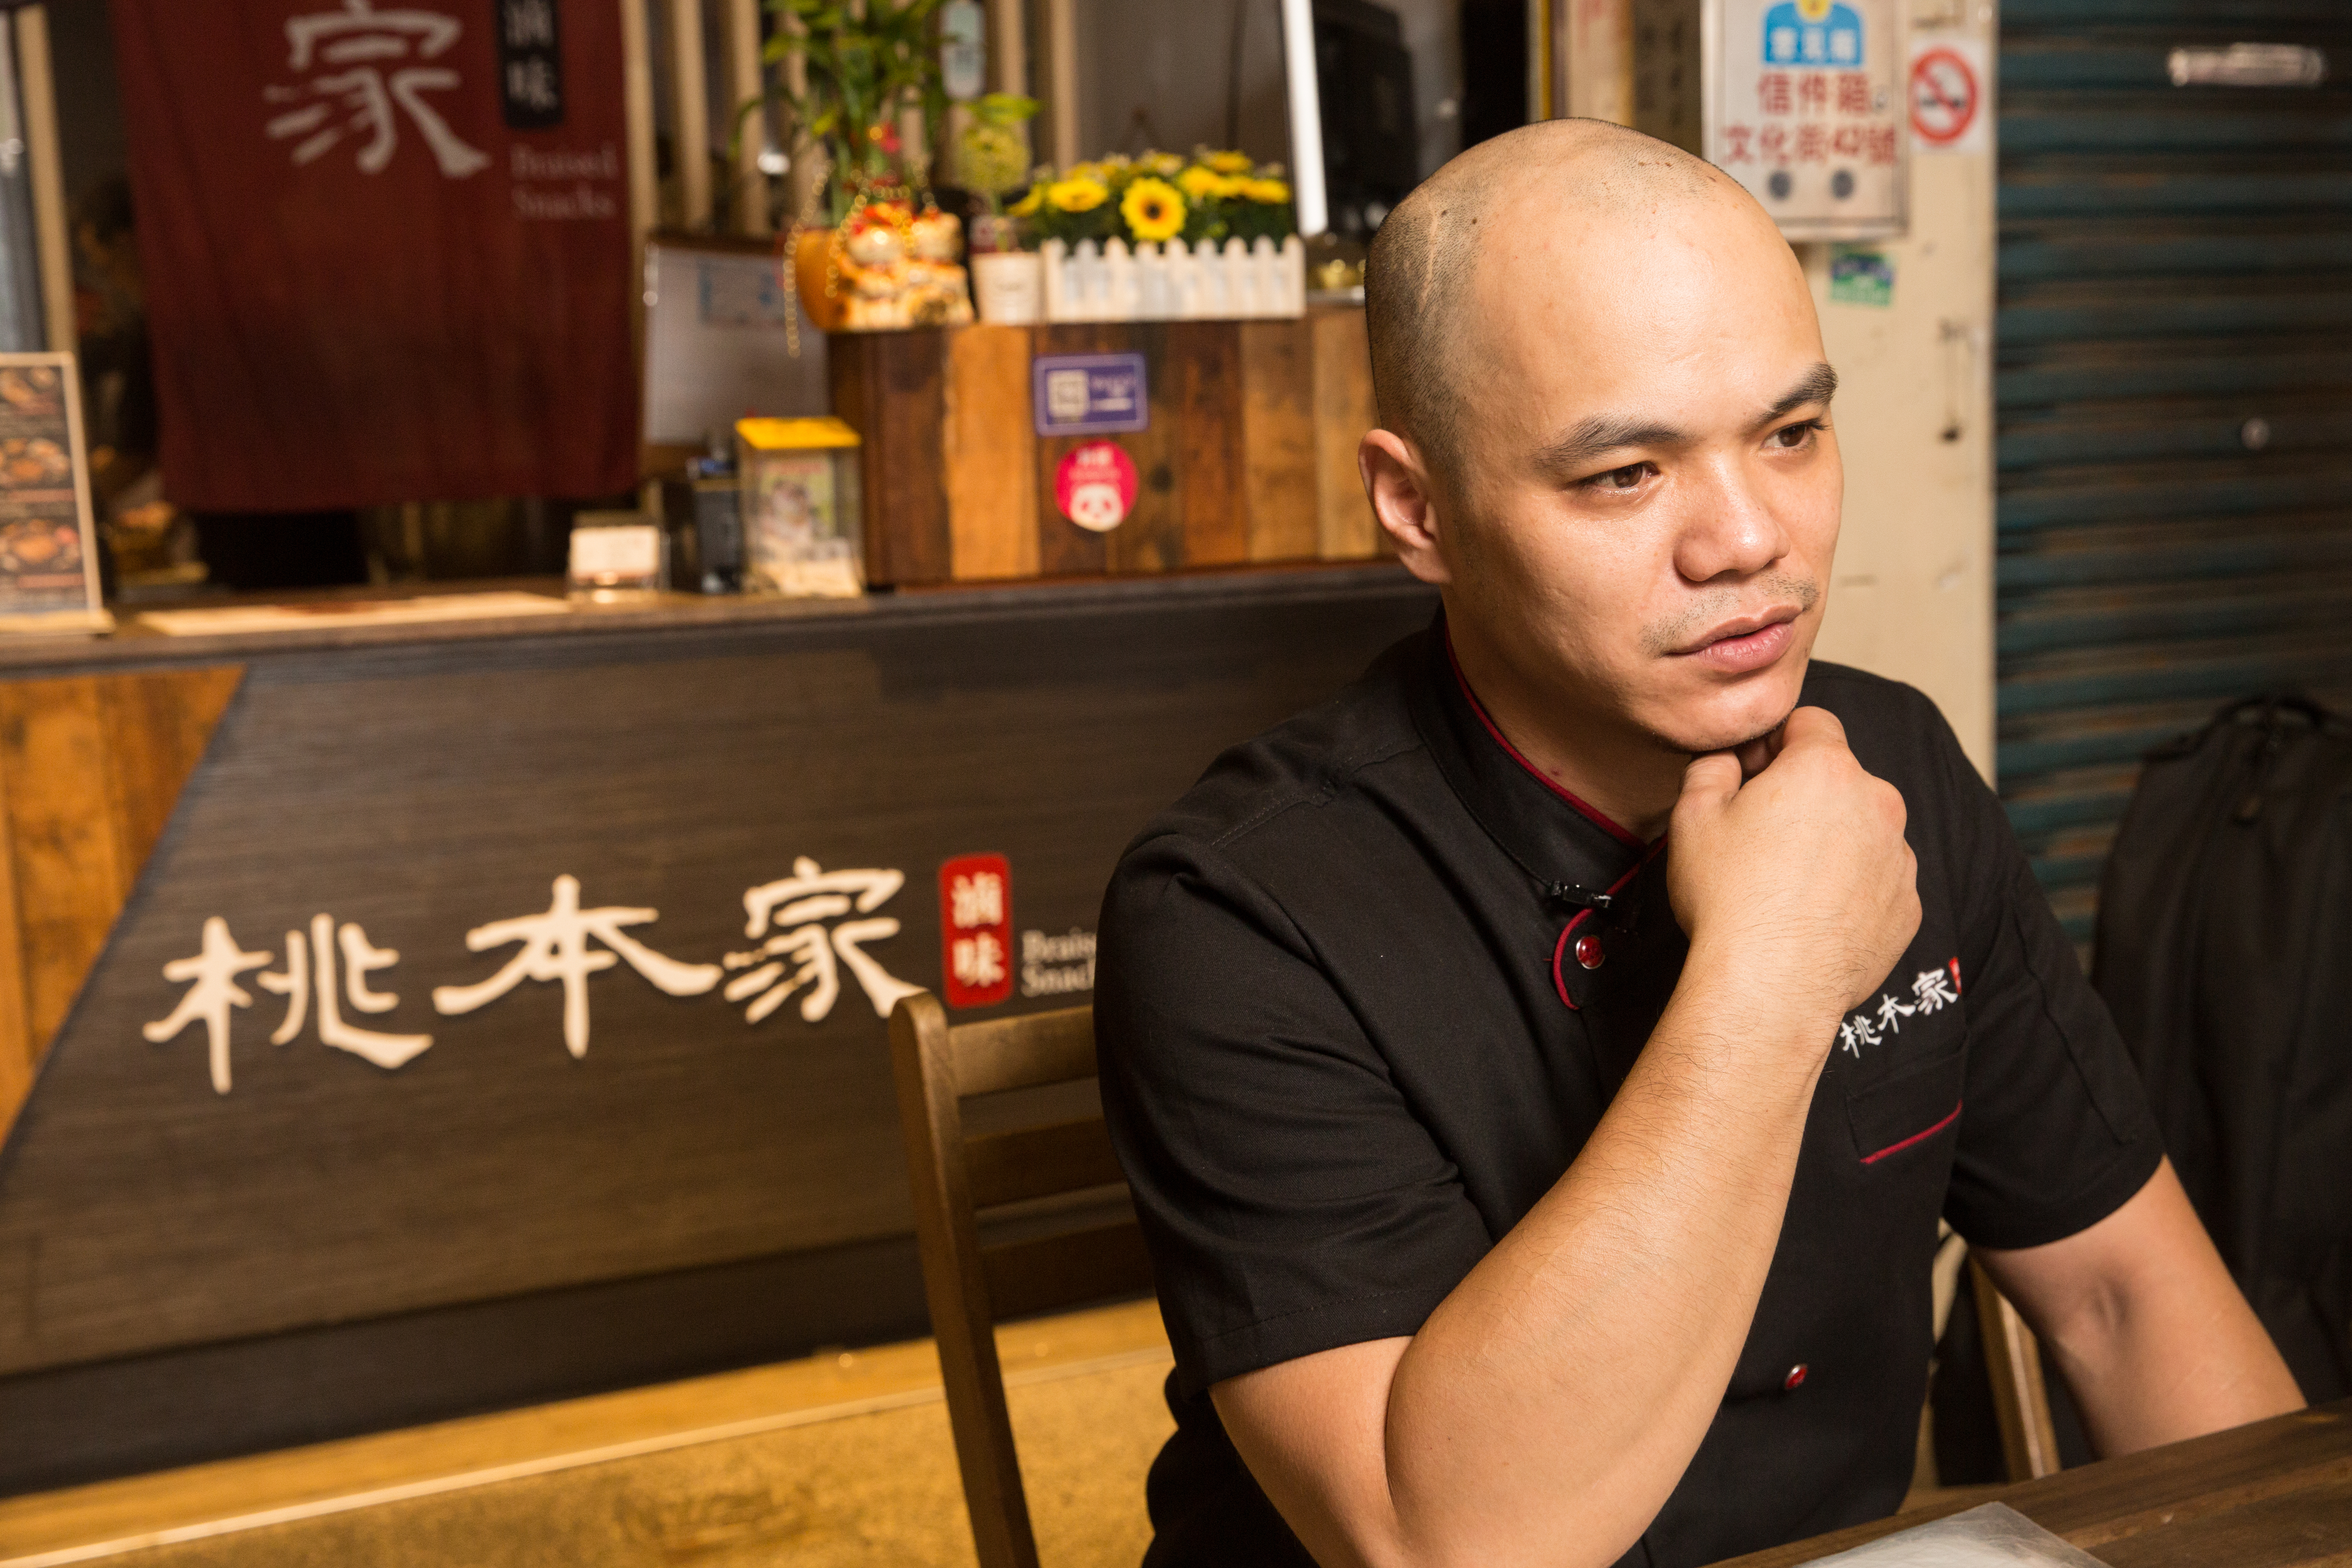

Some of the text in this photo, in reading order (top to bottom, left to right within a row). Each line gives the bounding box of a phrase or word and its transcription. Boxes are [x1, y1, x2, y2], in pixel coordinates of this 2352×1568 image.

[263, 0, 488, 176] 家
[1759, 71, 1868, 115] 信件箱
[143, 856, 924, 1092] 桃本家
[951, 871, 1005, 987] 滷味
[1022, 927, 1097, 964] Brais
[1840, 967, 1959, 1058] 桃本家
